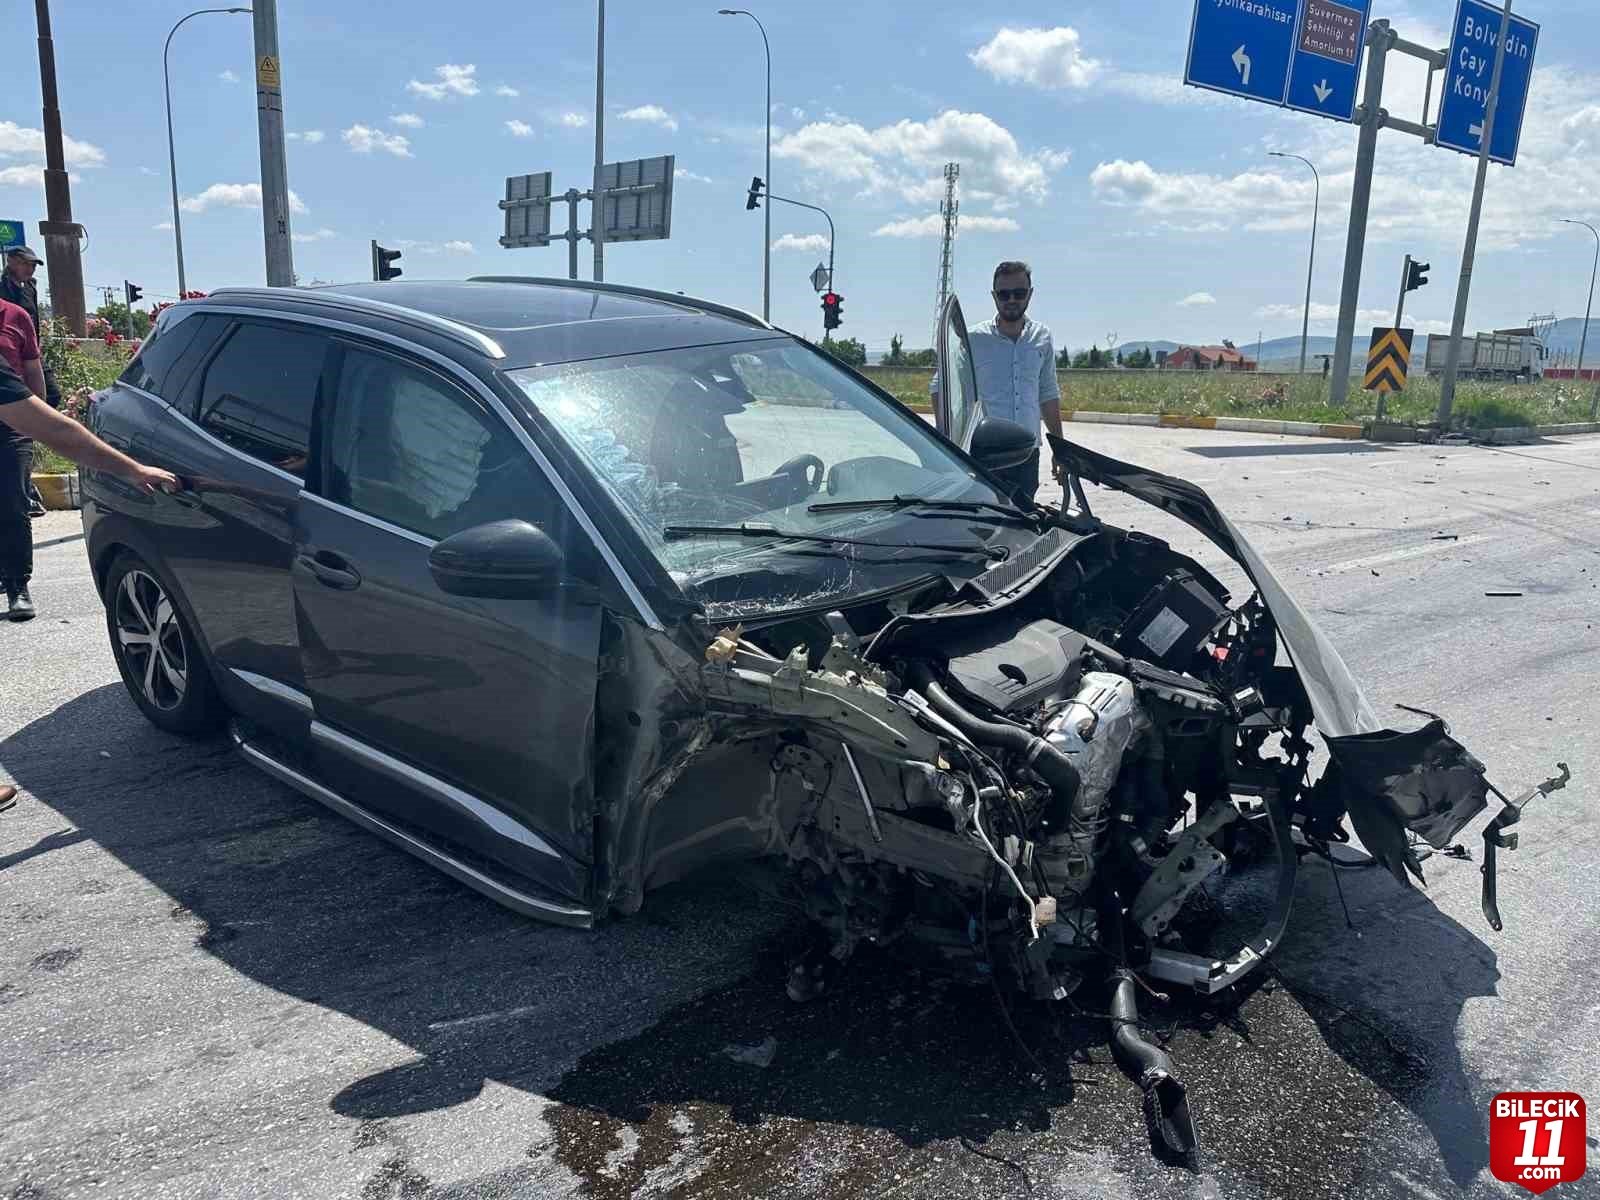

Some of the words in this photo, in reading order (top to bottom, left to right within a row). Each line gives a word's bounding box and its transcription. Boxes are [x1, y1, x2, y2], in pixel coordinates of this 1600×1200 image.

[1304, 36, 1343, 55] Amorium
[1459, 46, 1487, 78] Çay
[1454, 74, 1498, 108] Kony
